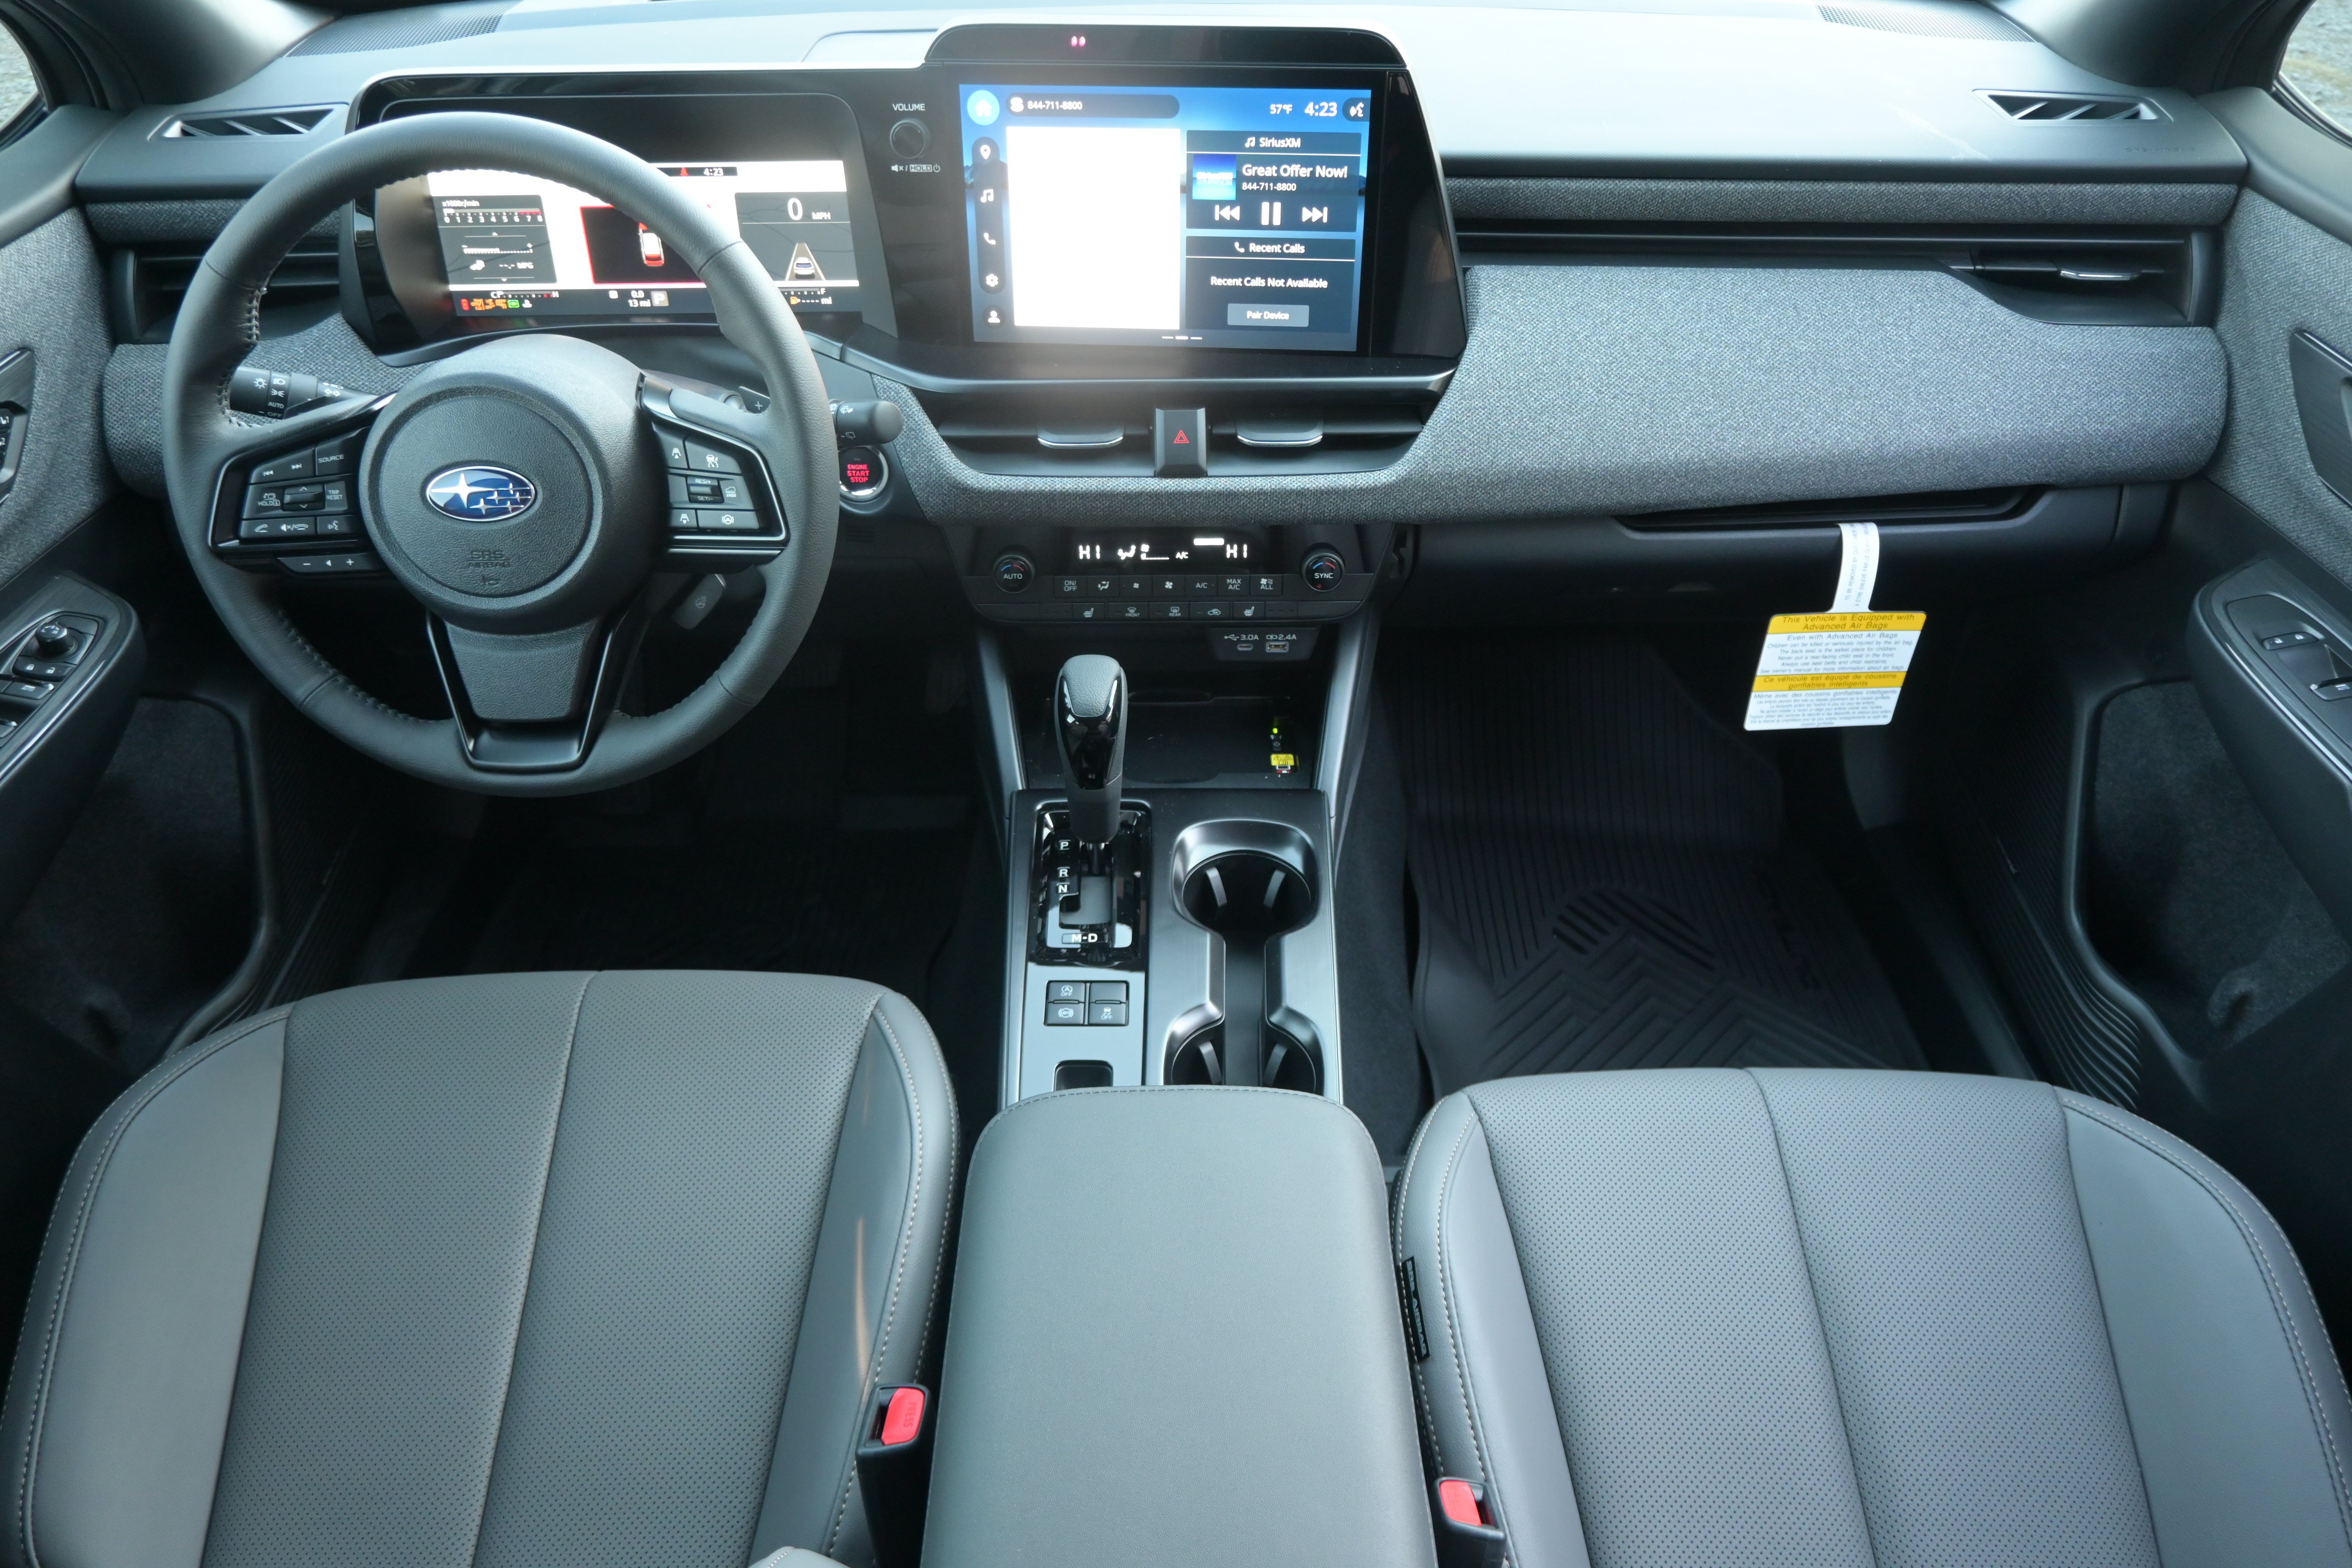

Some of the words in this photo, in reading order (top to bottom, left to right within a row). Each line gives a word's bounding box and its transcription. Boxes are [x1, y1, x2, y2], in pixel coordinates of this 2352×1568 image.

[1027, 101, 1082, 110] 844-711-8800
[1270, 103, 1292, 114] 57°F
[1304, 102, 1337, 116] 4:23
[1259, 137, 1301, 148] SiriusXM
[704, 168, 724, 176] 4:23
[1242, 164, 1277, 177] Great
[1280, 164, 1312, 177] Offer
[1315, 166, 1348, 177] Now!
[1241, 182, 1296, 191] 844-711-8800
[788, 198, 803, 220] 0
[1249, 243, 1281, 253] Recent
[1283, 243, 1305, 253] Calls
[1211, 276, 1242, 286] Recent
[1244, 277, 1265, 287] Calls
[1267, 278, 1284, 287] Not
[1286, 278, 1328, 288] Available
[654, 293, 664, 304] P
[1247, 311, 1262, 319] Pair
[1263, 311, 1289, 320] Device
[318, 454, 343, 463] SOURCE
[471, 550, 504, 560] SRS
[1060, 841, 1069, 849] P
[1059, 869, 1068, 877] R
[1058, 885, 1068, 893] N
[1071, 933, 1098, 942] M-D
